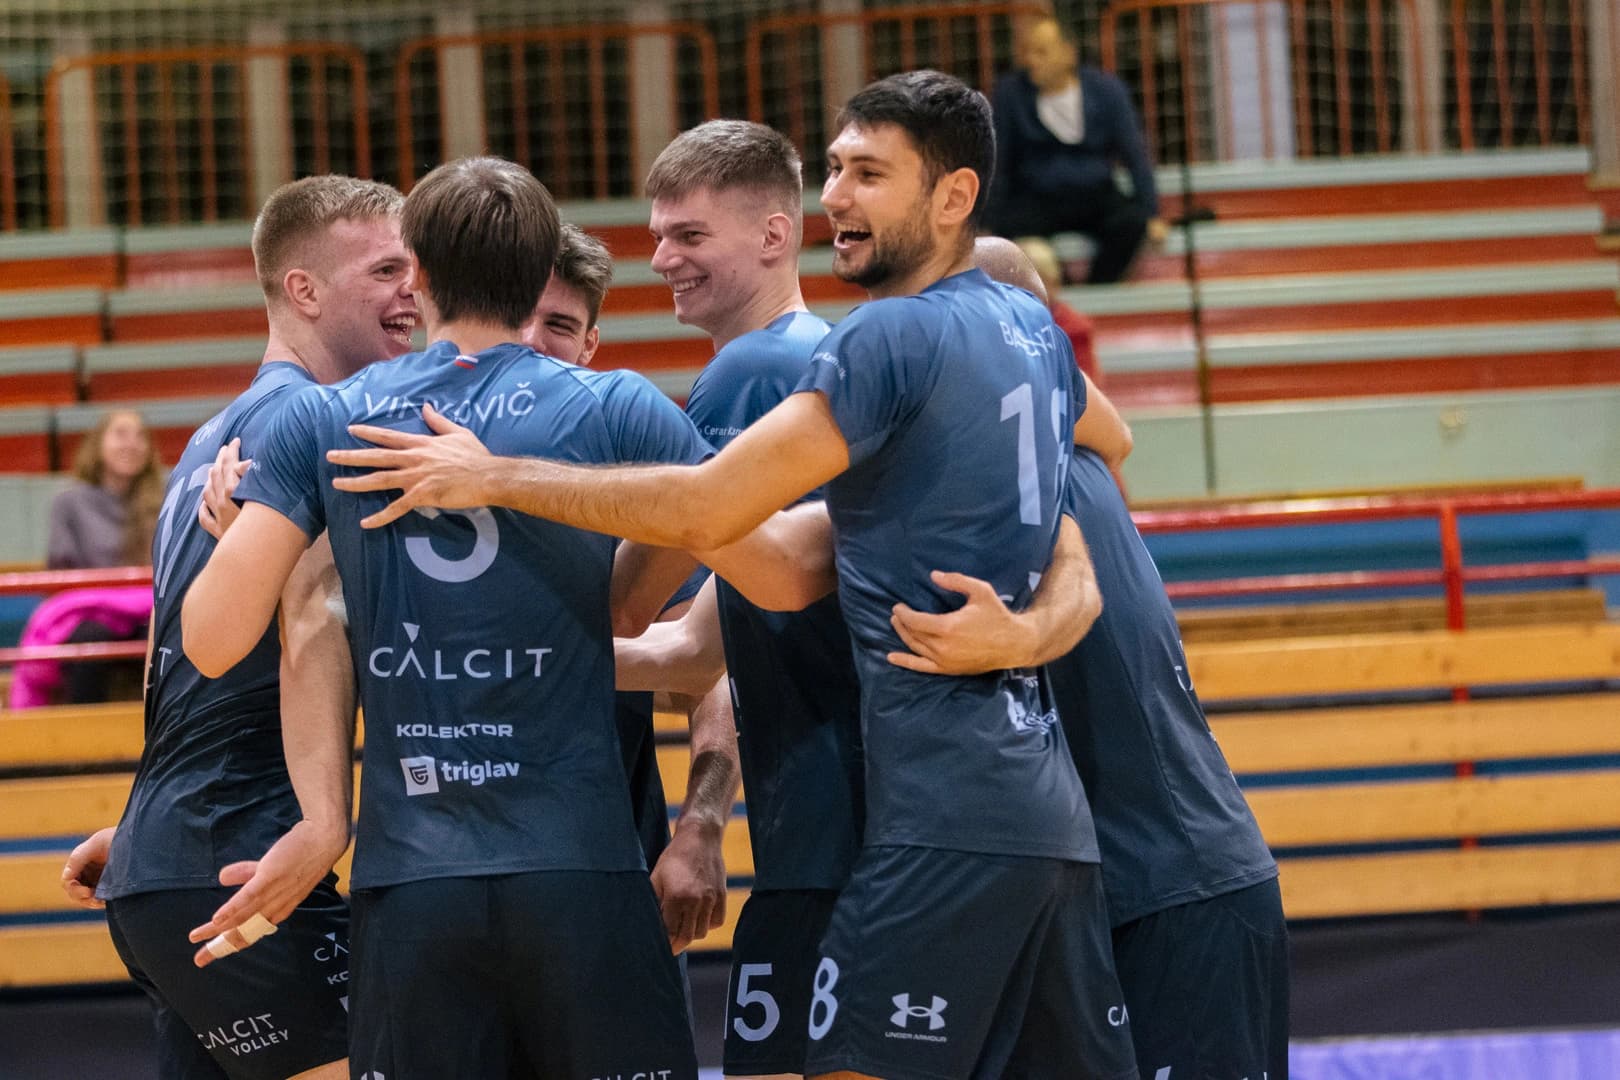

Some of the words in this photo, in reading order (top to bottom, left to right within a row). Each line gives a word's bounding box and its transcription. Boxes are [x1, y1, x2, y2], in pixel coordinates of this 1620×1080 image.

[368, 646, 553, 680] CALCIT
[396, 723, 513, 739] KOLEKTOR
[441, 760, 520, 786] triglav
[724, 963, 780, 1041] 5
[230, 1029, 289, 1057] VOLLEY
